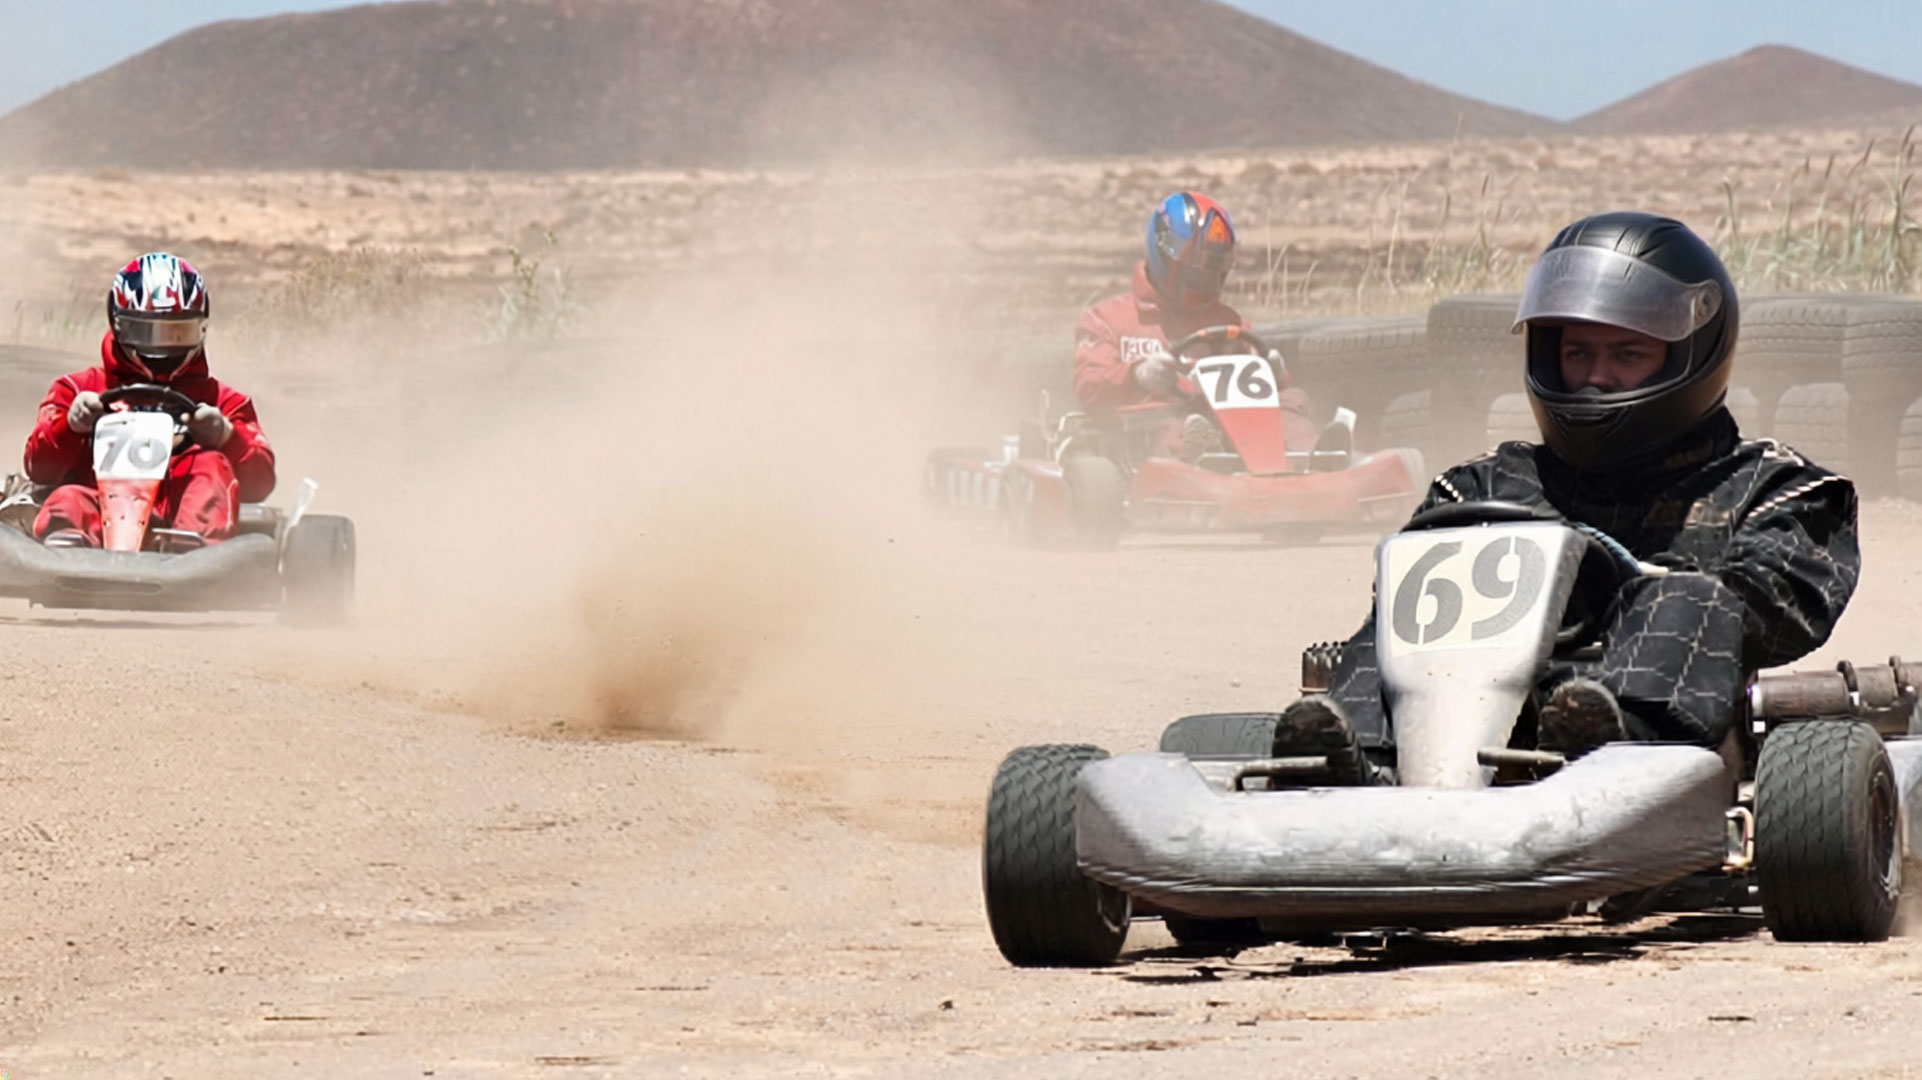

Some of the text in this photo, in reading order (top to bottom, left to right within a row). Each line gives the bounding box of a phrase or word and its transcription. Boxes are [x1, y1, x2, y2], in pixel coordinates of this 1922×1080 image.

[1199, 361, 1273, 402] 76
[96, 426, 168, 472] 70
[1392, 536, 1547, 645] 69
